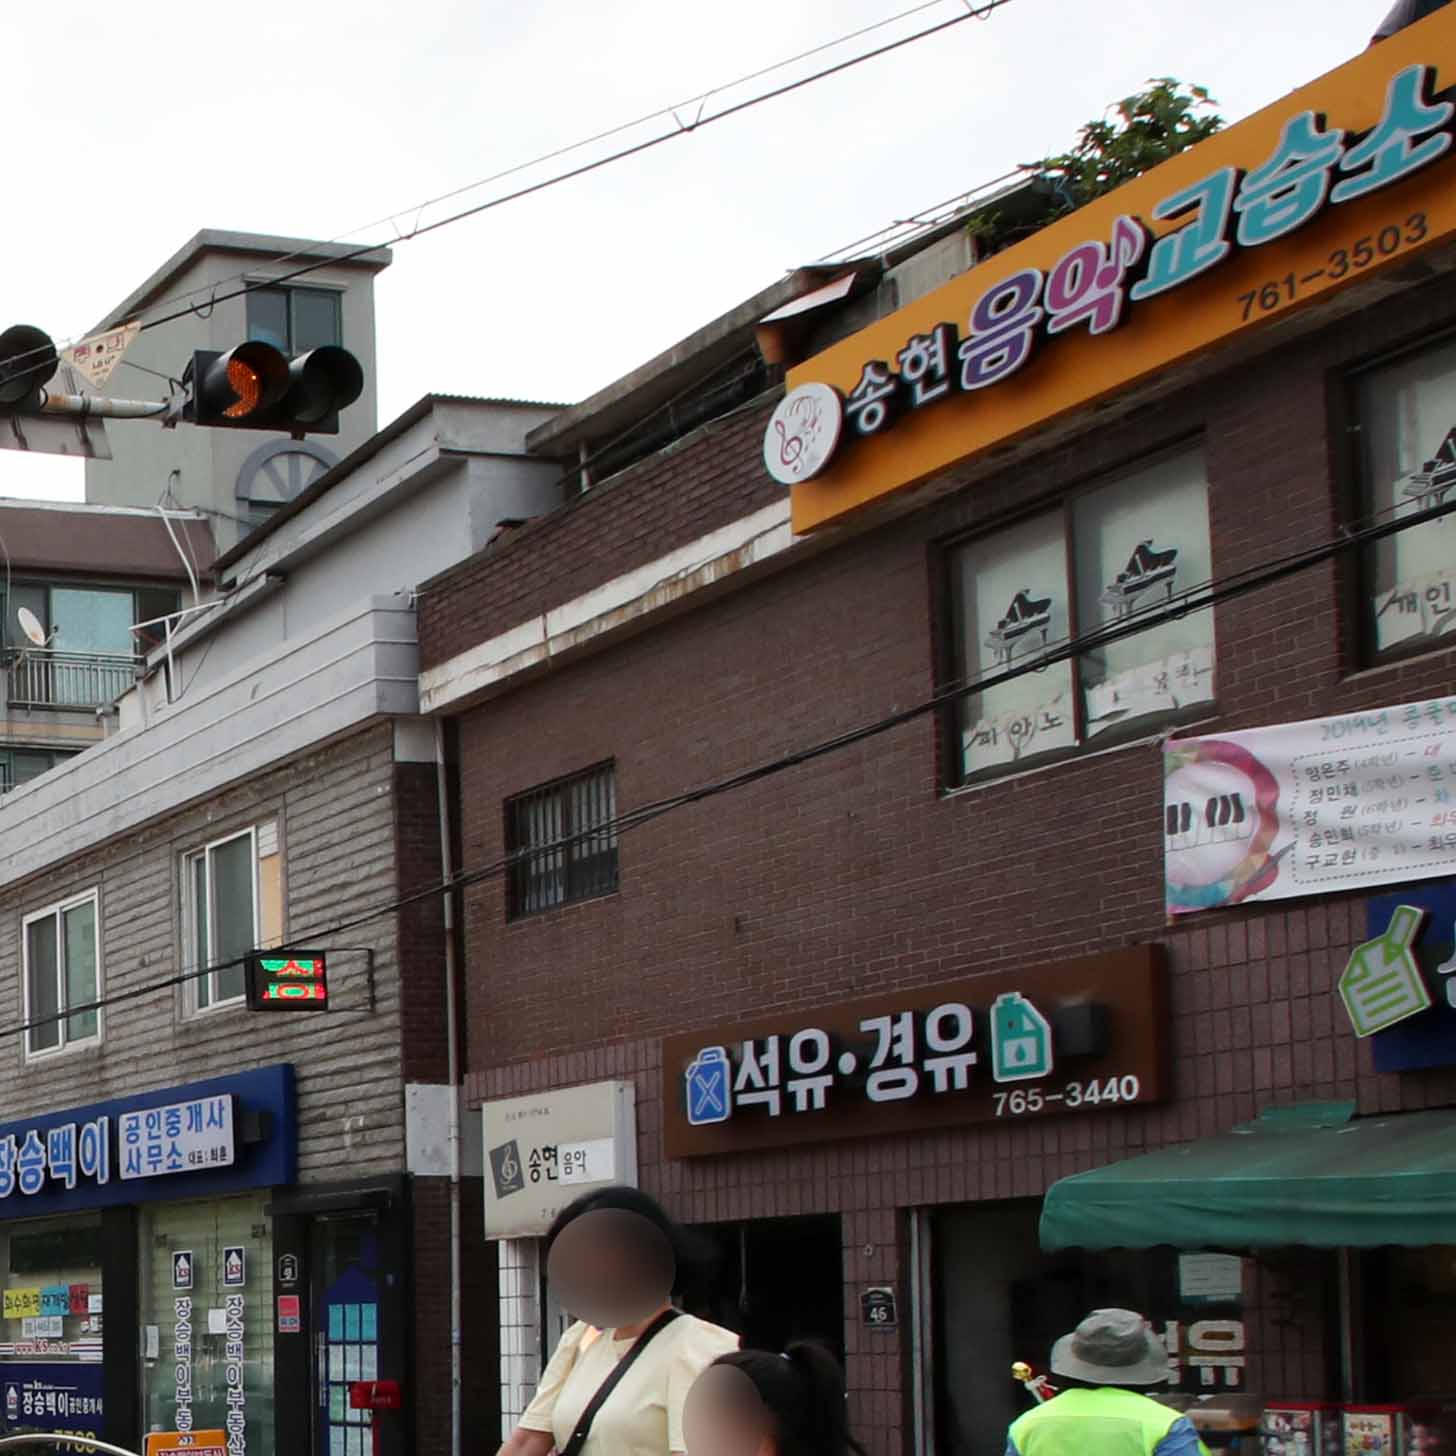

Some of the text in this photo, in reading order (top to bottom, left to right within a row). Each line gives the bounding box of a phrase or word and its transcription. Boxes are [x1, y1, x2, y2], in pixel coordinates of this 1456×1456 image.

[1238, 212, 1430, 322] 761-3503
[993, 1075, 1139, 1116] 765-3440
[126, 1099, 224, 1144] 공인중개사
[126, 1141, 183, 1175] 사무소
[529, 1146, 586, 1183] 송현 음악
[870, 1307, 887, 1321] 46
[175, 1297, 192, 1445] 장승백이부동
[23, 1391, 69, 1417] 장승백이
